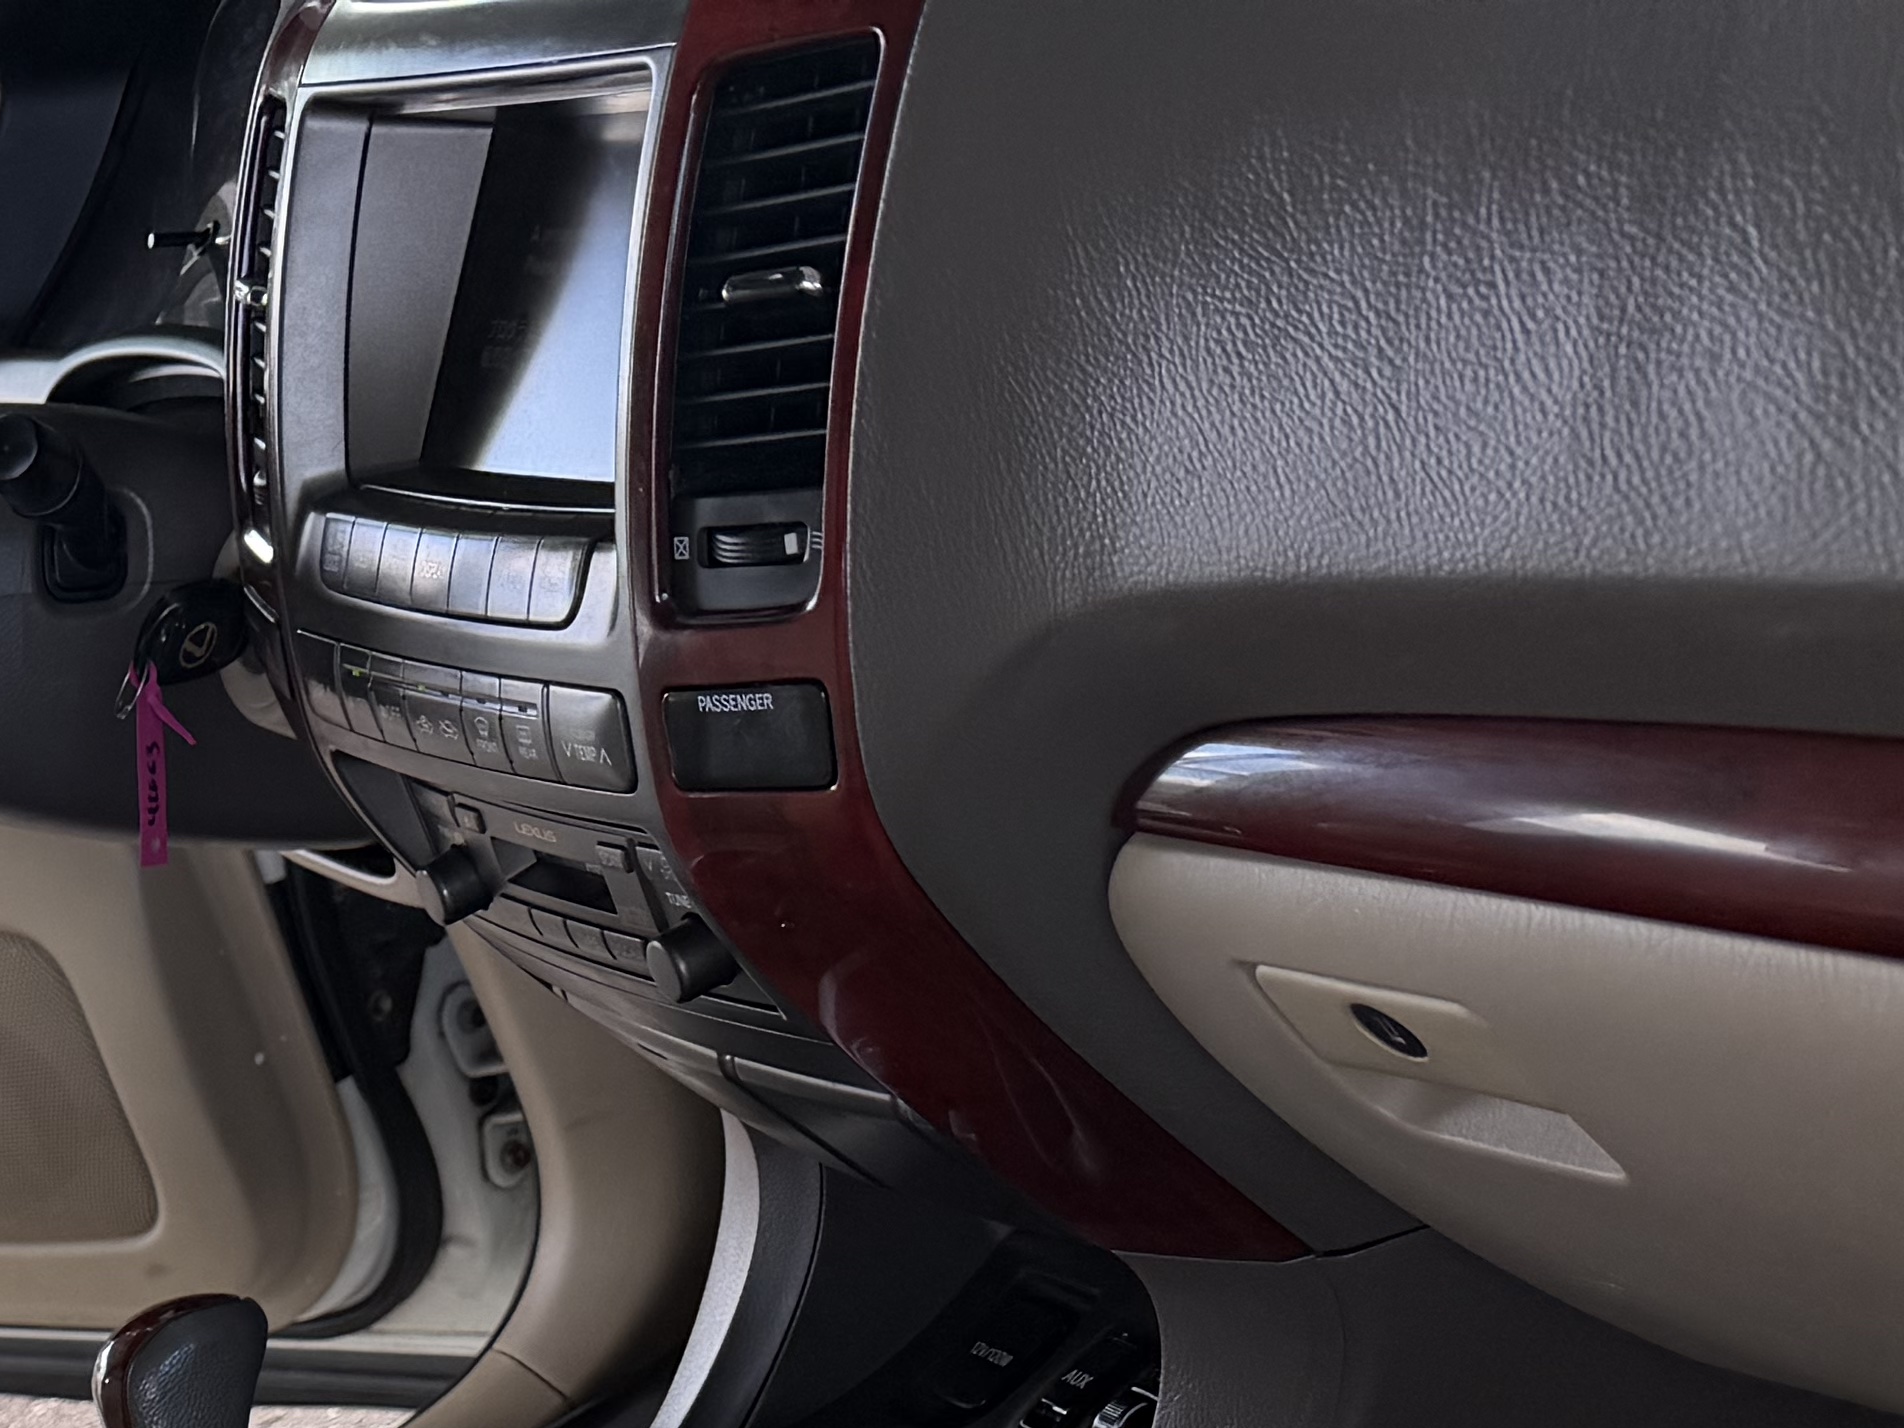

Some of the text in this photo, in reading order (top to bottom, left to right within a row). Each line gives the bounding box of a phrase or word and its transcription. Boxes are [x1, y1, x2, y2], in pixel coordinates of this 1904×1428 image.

[697, 692, 774, 713] PASSENGER
[513, 821, 557, 843] LEXUS
[1061, 1369, 1094, 1390] AUX
